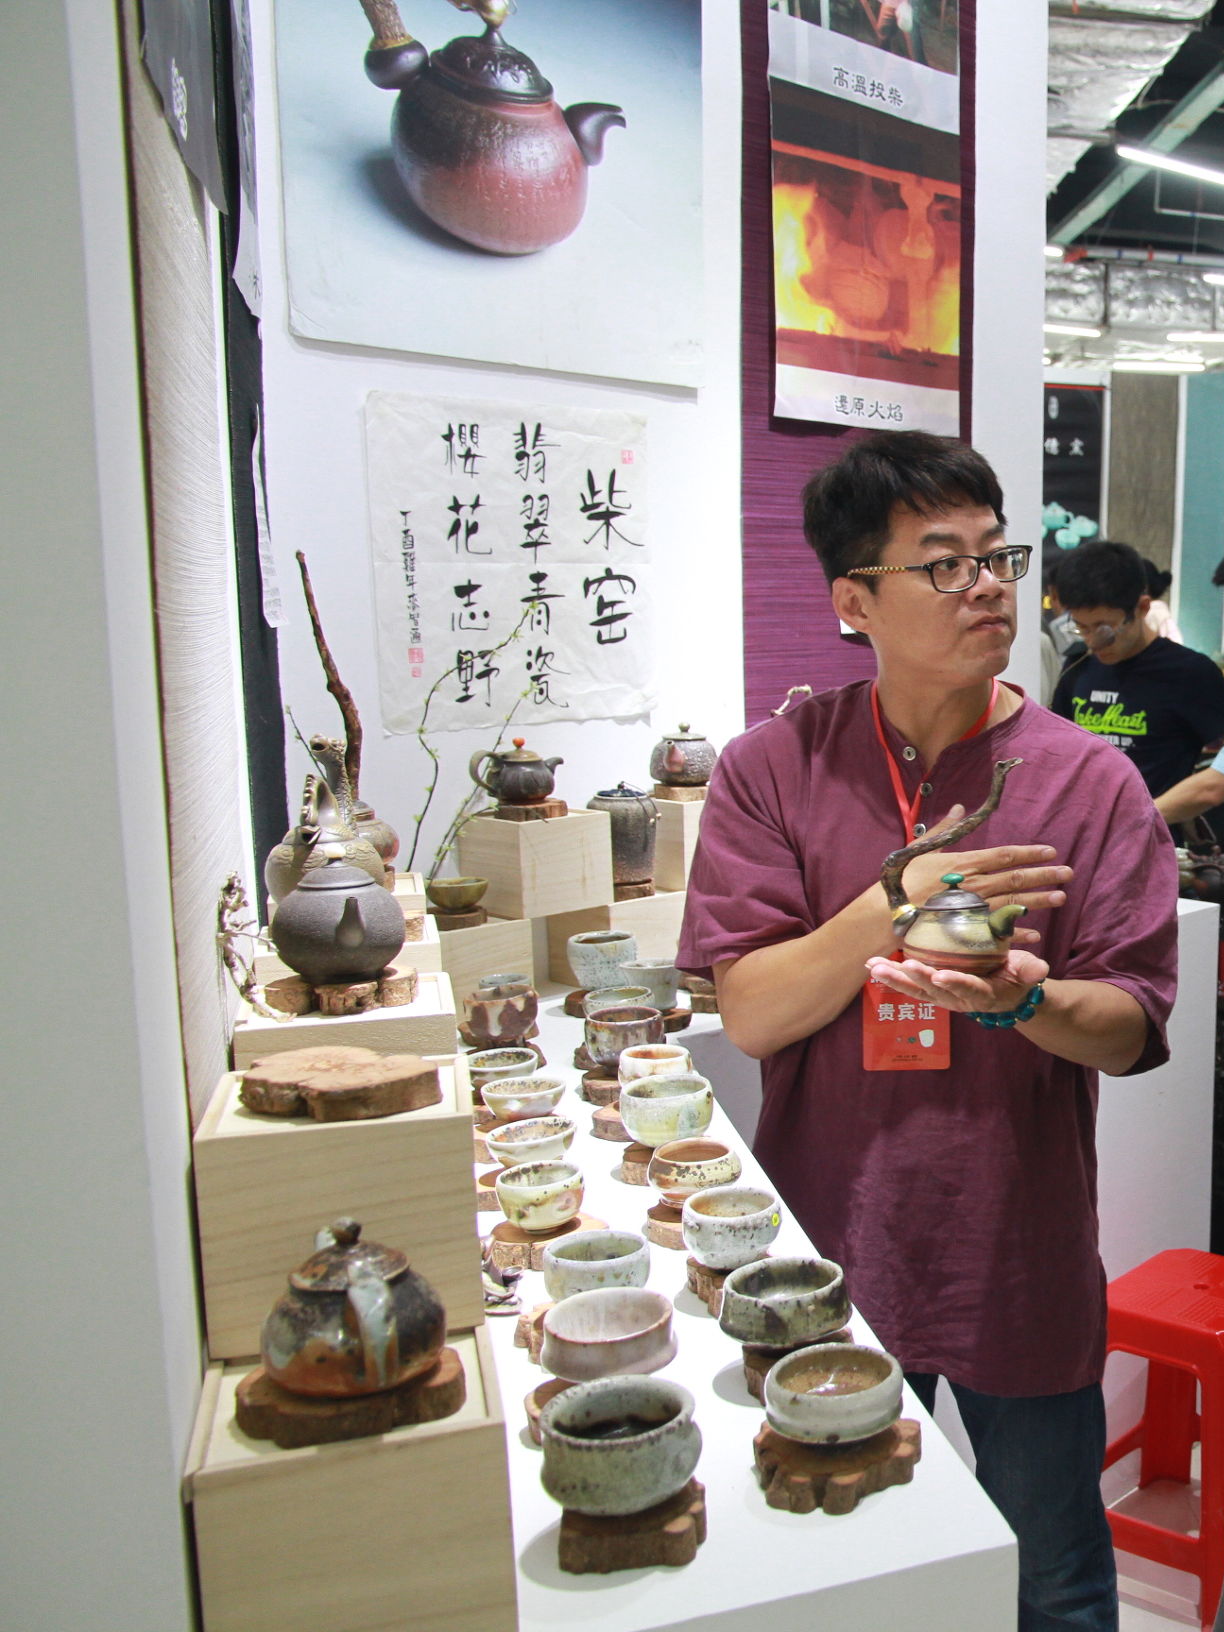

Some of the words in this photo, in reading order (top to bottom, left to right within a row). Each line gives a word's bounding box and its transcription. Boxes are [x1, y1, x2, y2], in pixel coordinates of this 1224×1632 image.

[834, 394, 904, 422] 還原火焰
[877, 1003, 936, 1022] 贵宾证
